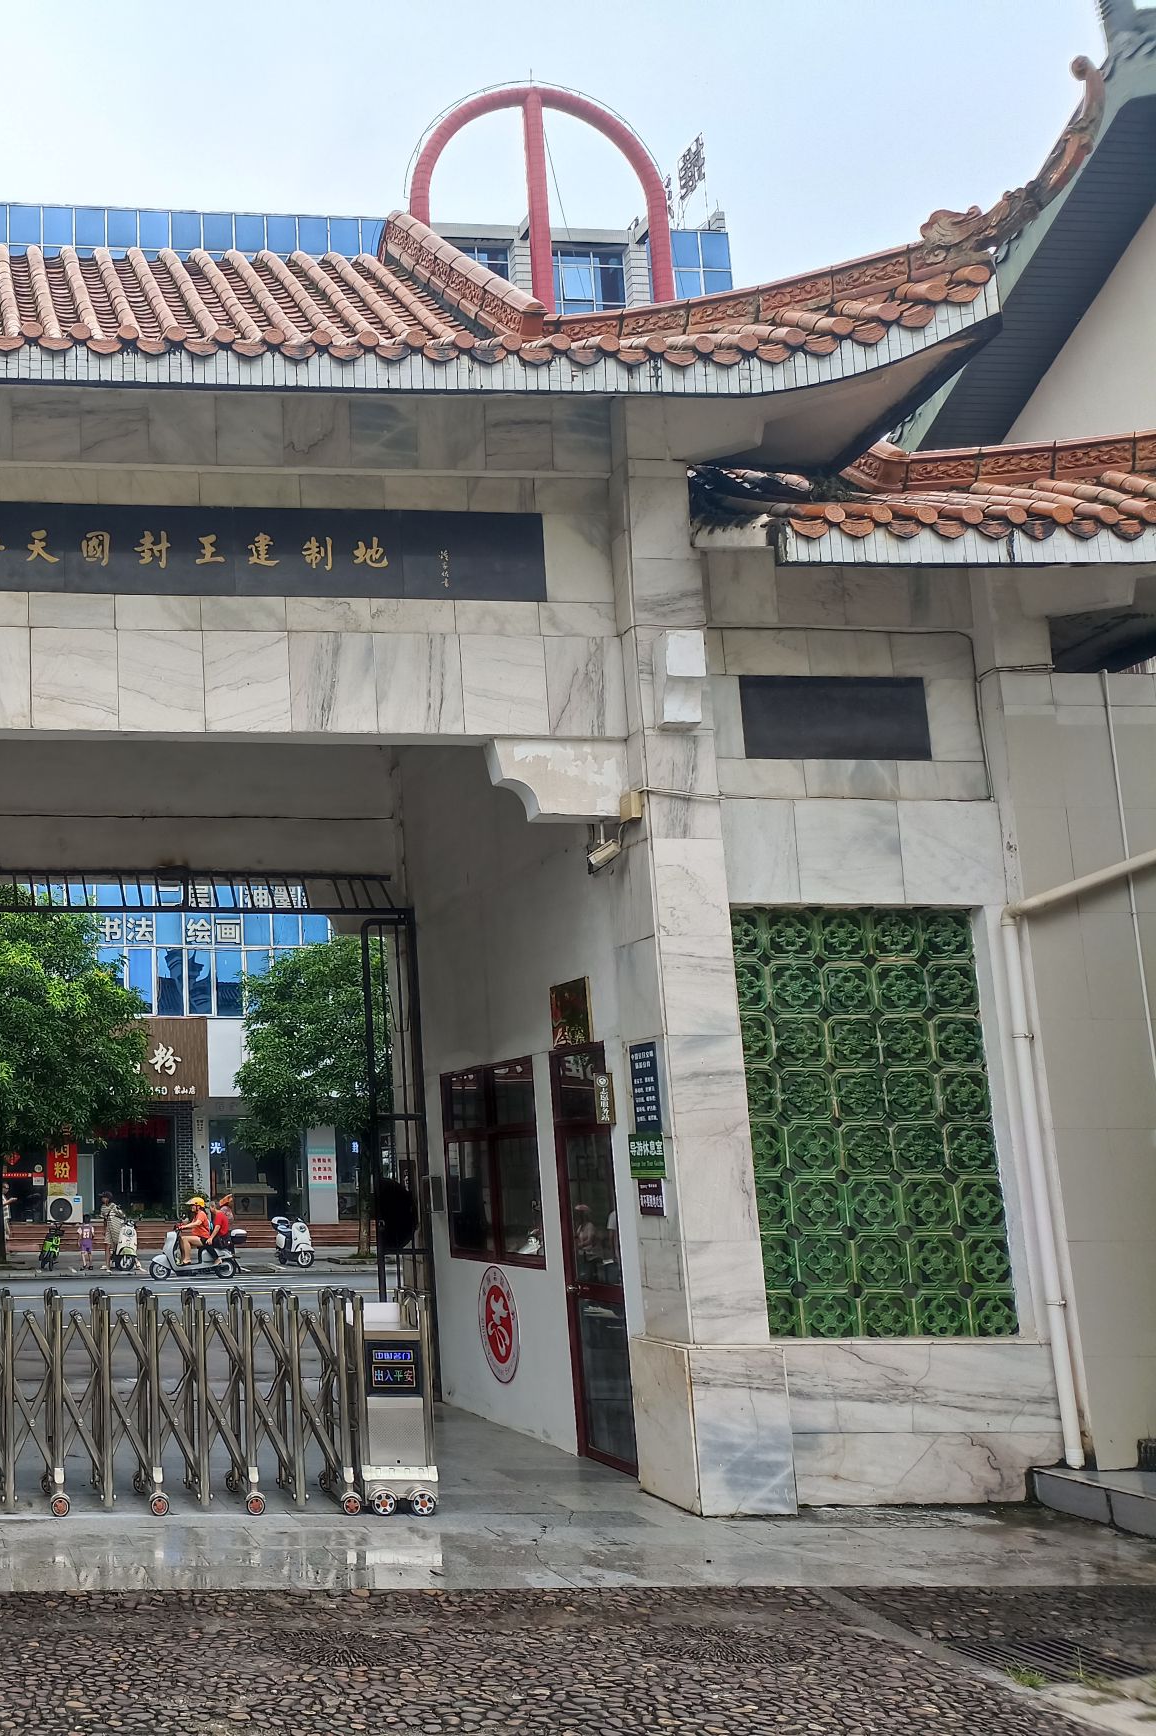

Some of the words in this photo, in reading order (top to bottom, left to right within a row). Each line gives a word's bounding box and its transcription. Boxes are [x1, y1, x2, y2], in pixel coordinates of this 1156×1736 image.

[101, 917, 154, 942] 书法
[186, 918, 241, 944] 绘画
[630, 1140, 664, 1157] 导游休息室
[374, 1369, 413, 1382] 出入平安
